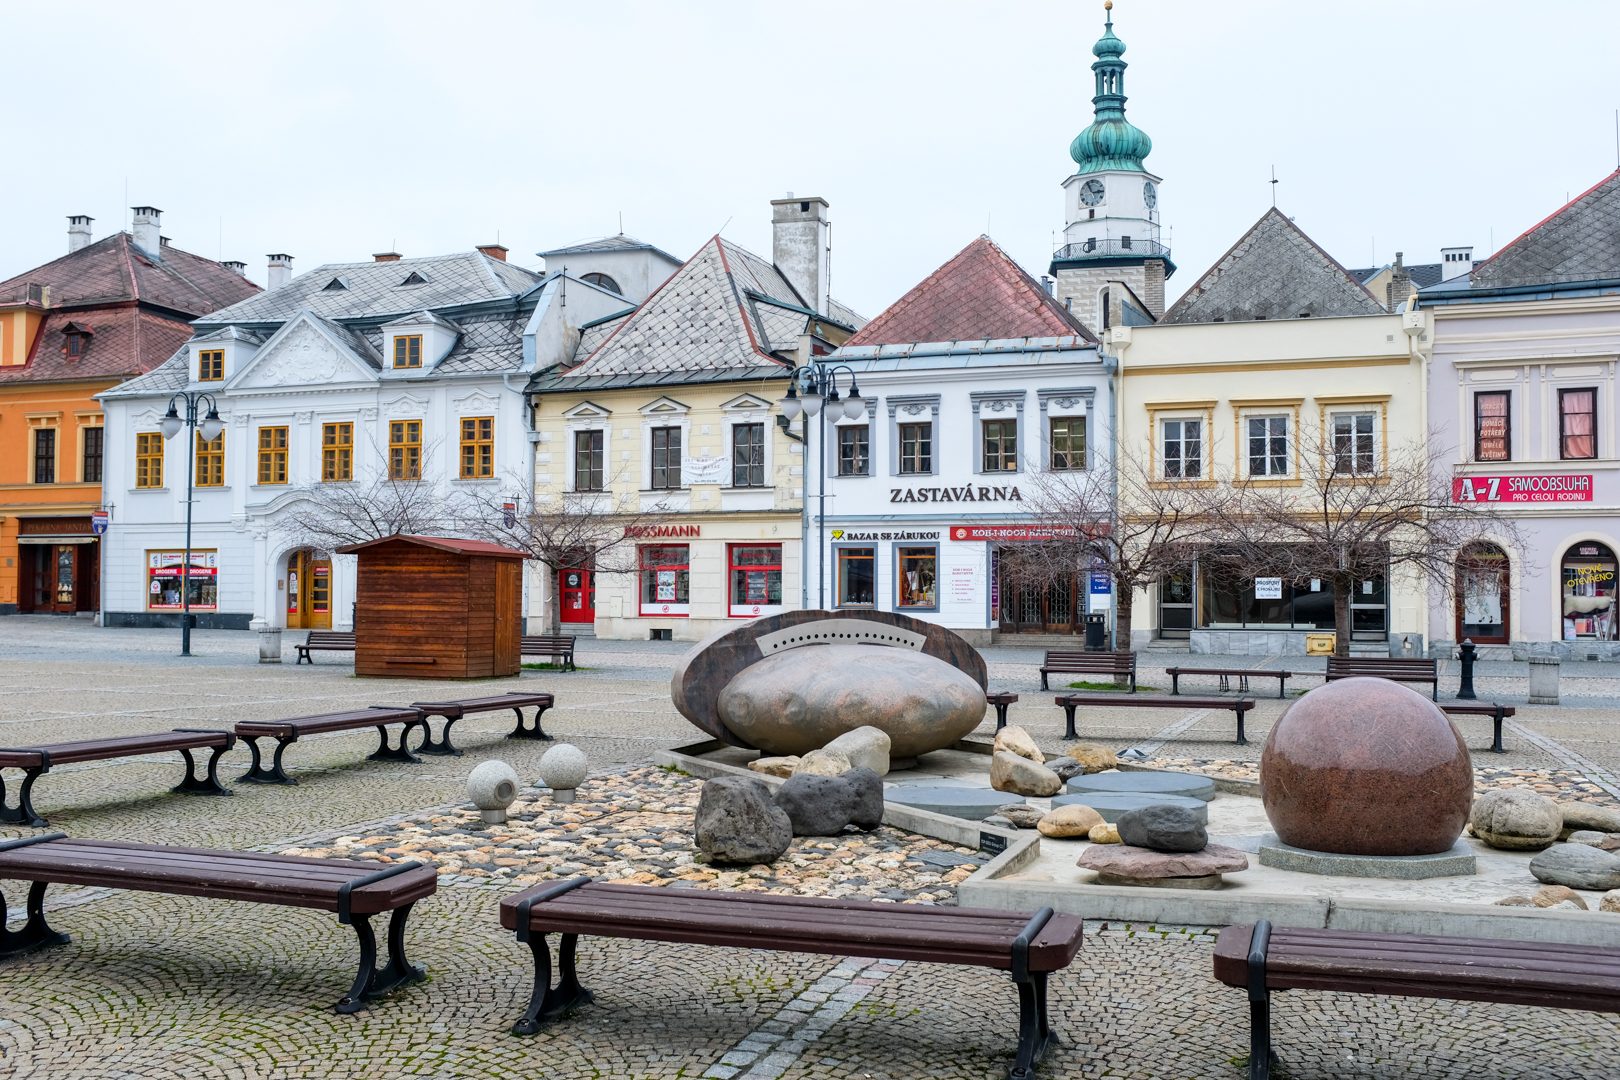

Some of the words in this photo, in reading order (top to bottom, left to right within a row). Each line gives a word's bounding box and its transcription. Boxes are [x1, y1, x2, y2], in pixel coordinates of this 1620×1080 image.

[1480, 428, 1506, 436] POTŘEBY
[890, 483, 1023, 503] ZASTAVÁRNA
[1459, 478, 1501, 501] A-Z
[1508, 476, 1589, 492] SAMOOBSLUHA
[1513, 493, 1528, 501] PRO
[1531, 493, 1554, 501] CELOU
[1557, 492, 1586, 501] RODINU
[625, 525, 700, 537] ROSSMANN
[893, 530, 940, 540] ZÁRUKOU
[1567, 572, 1614, 588] OTEVŘENO
